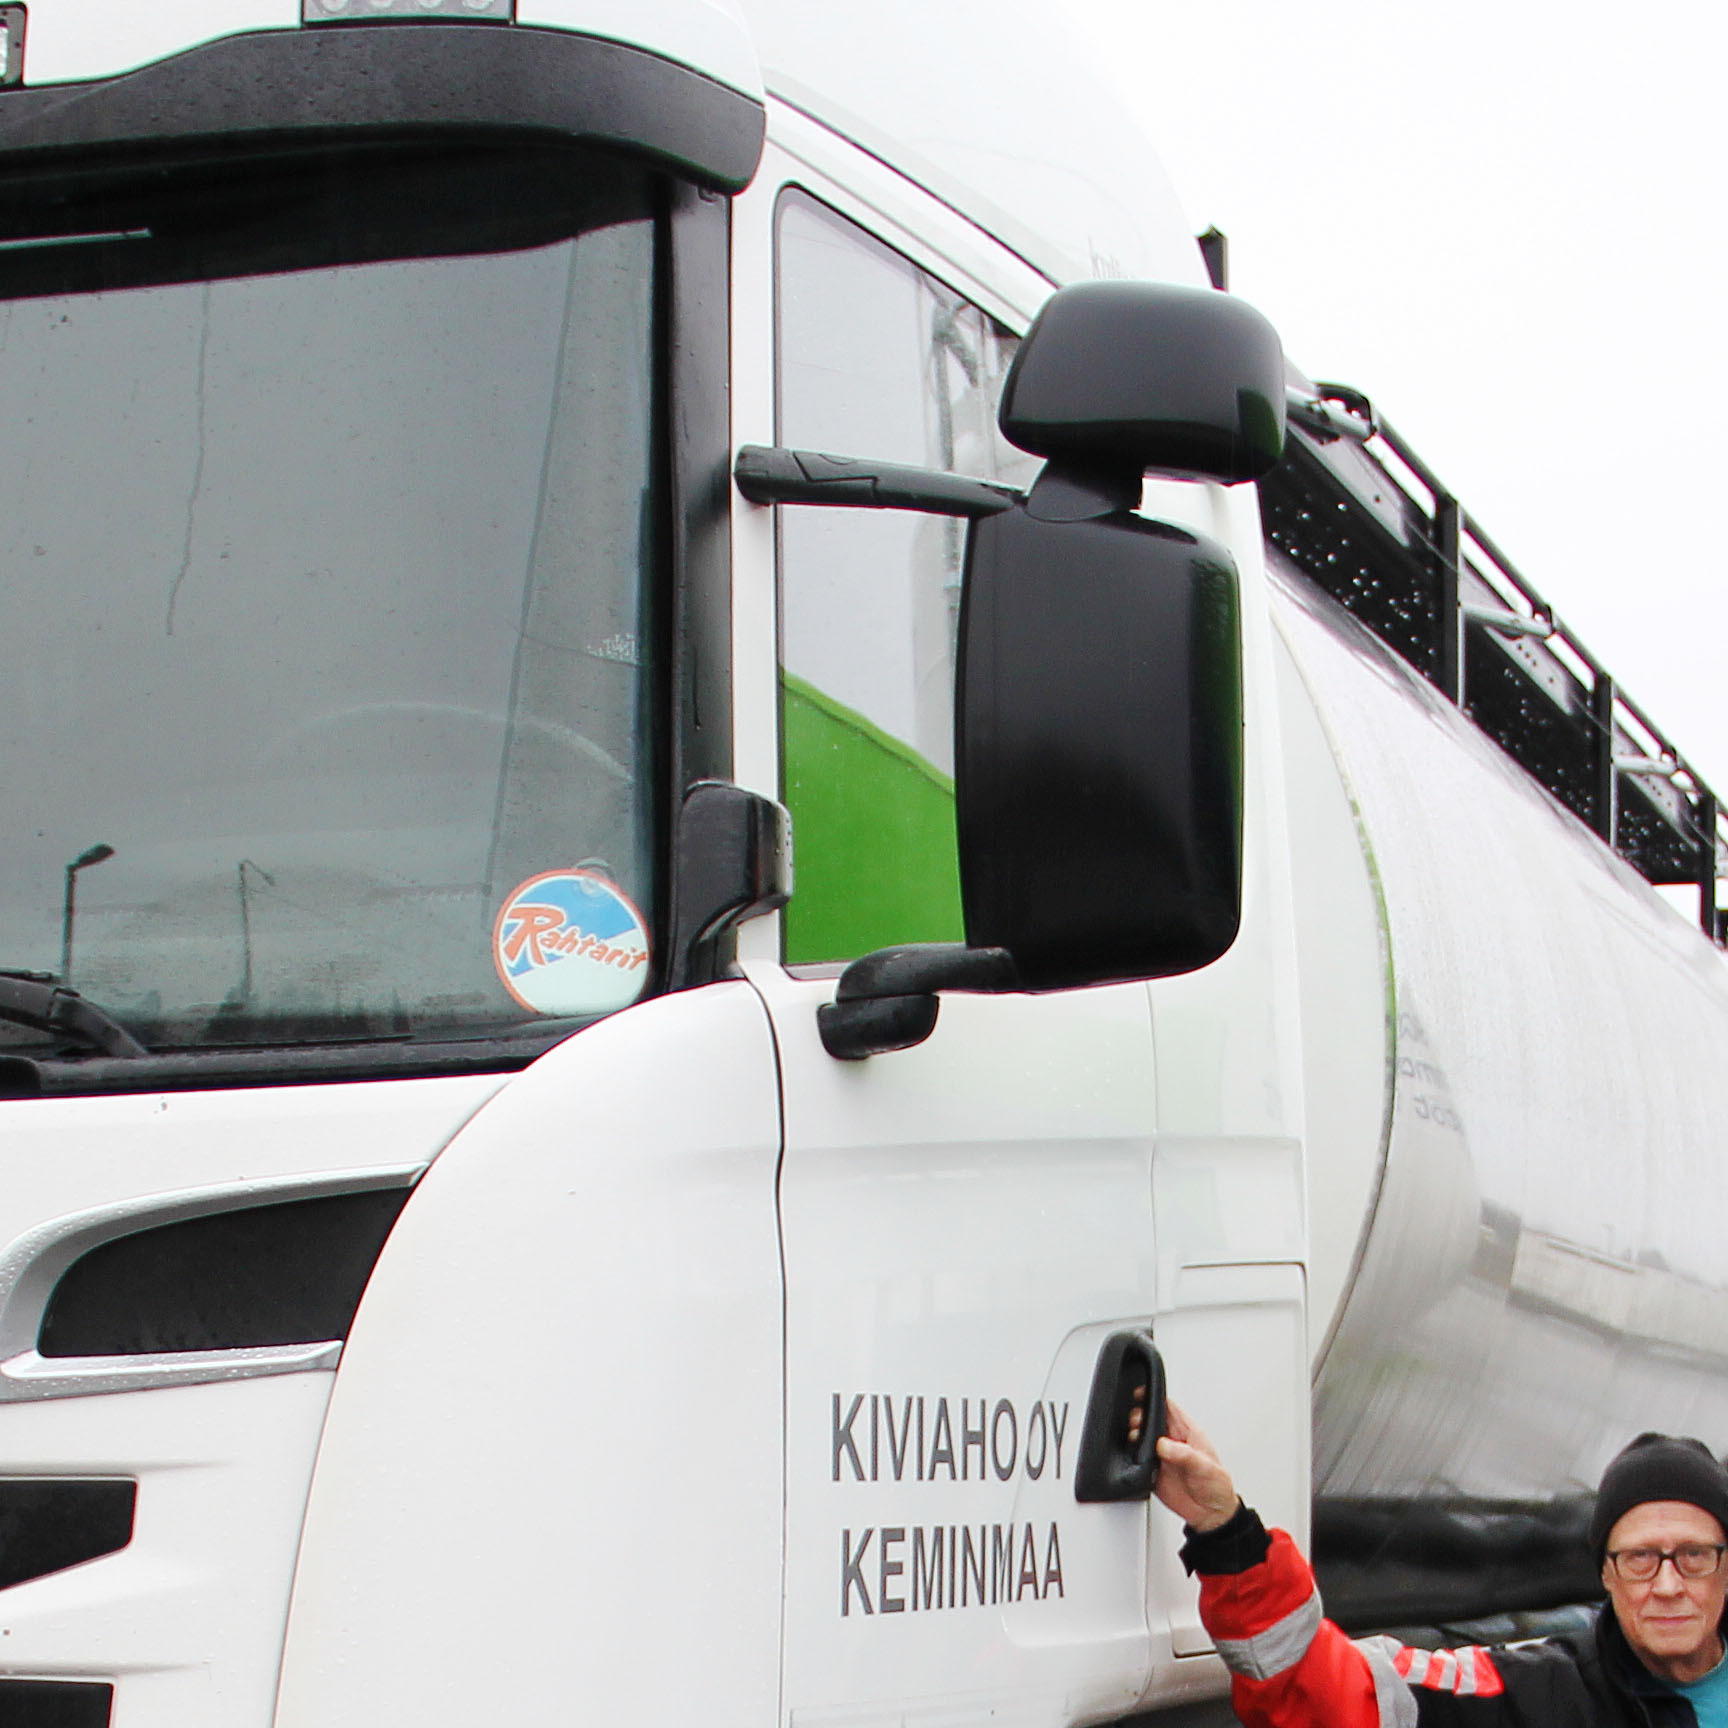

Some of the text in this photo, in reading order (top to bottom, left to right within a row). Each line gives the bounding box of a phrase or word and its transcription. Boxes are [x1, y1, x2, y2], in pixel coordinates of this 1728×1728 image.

[504, 906, 647, 971] Rahtarit
[832, 1392, 1069, 1482] KIVIAHO OY
[841, 1521, 1065, 1617] KEMINMAA
